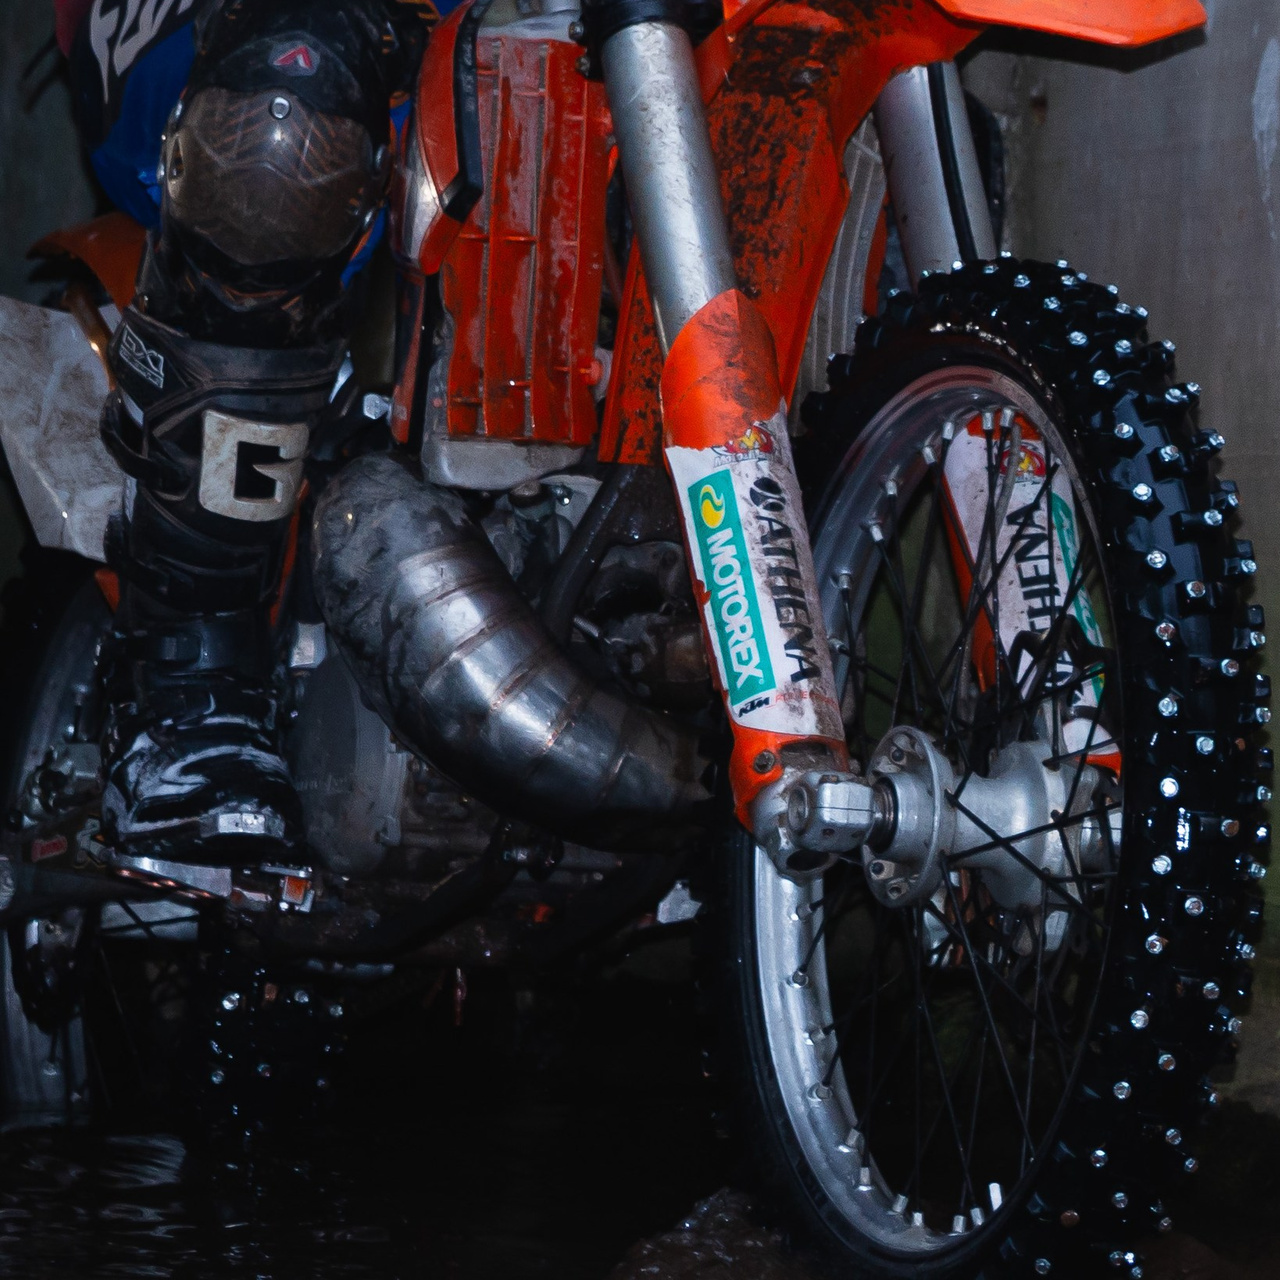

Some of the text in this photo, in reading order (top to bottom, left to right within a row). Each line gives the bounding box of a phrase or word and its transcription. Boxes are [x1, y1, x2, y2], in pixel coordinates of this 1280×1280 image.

[706, 527, 764, 690] MOTOREX
[756, 516, 821, 683] ATHENA
[738, 696, 770, 718] KTM
